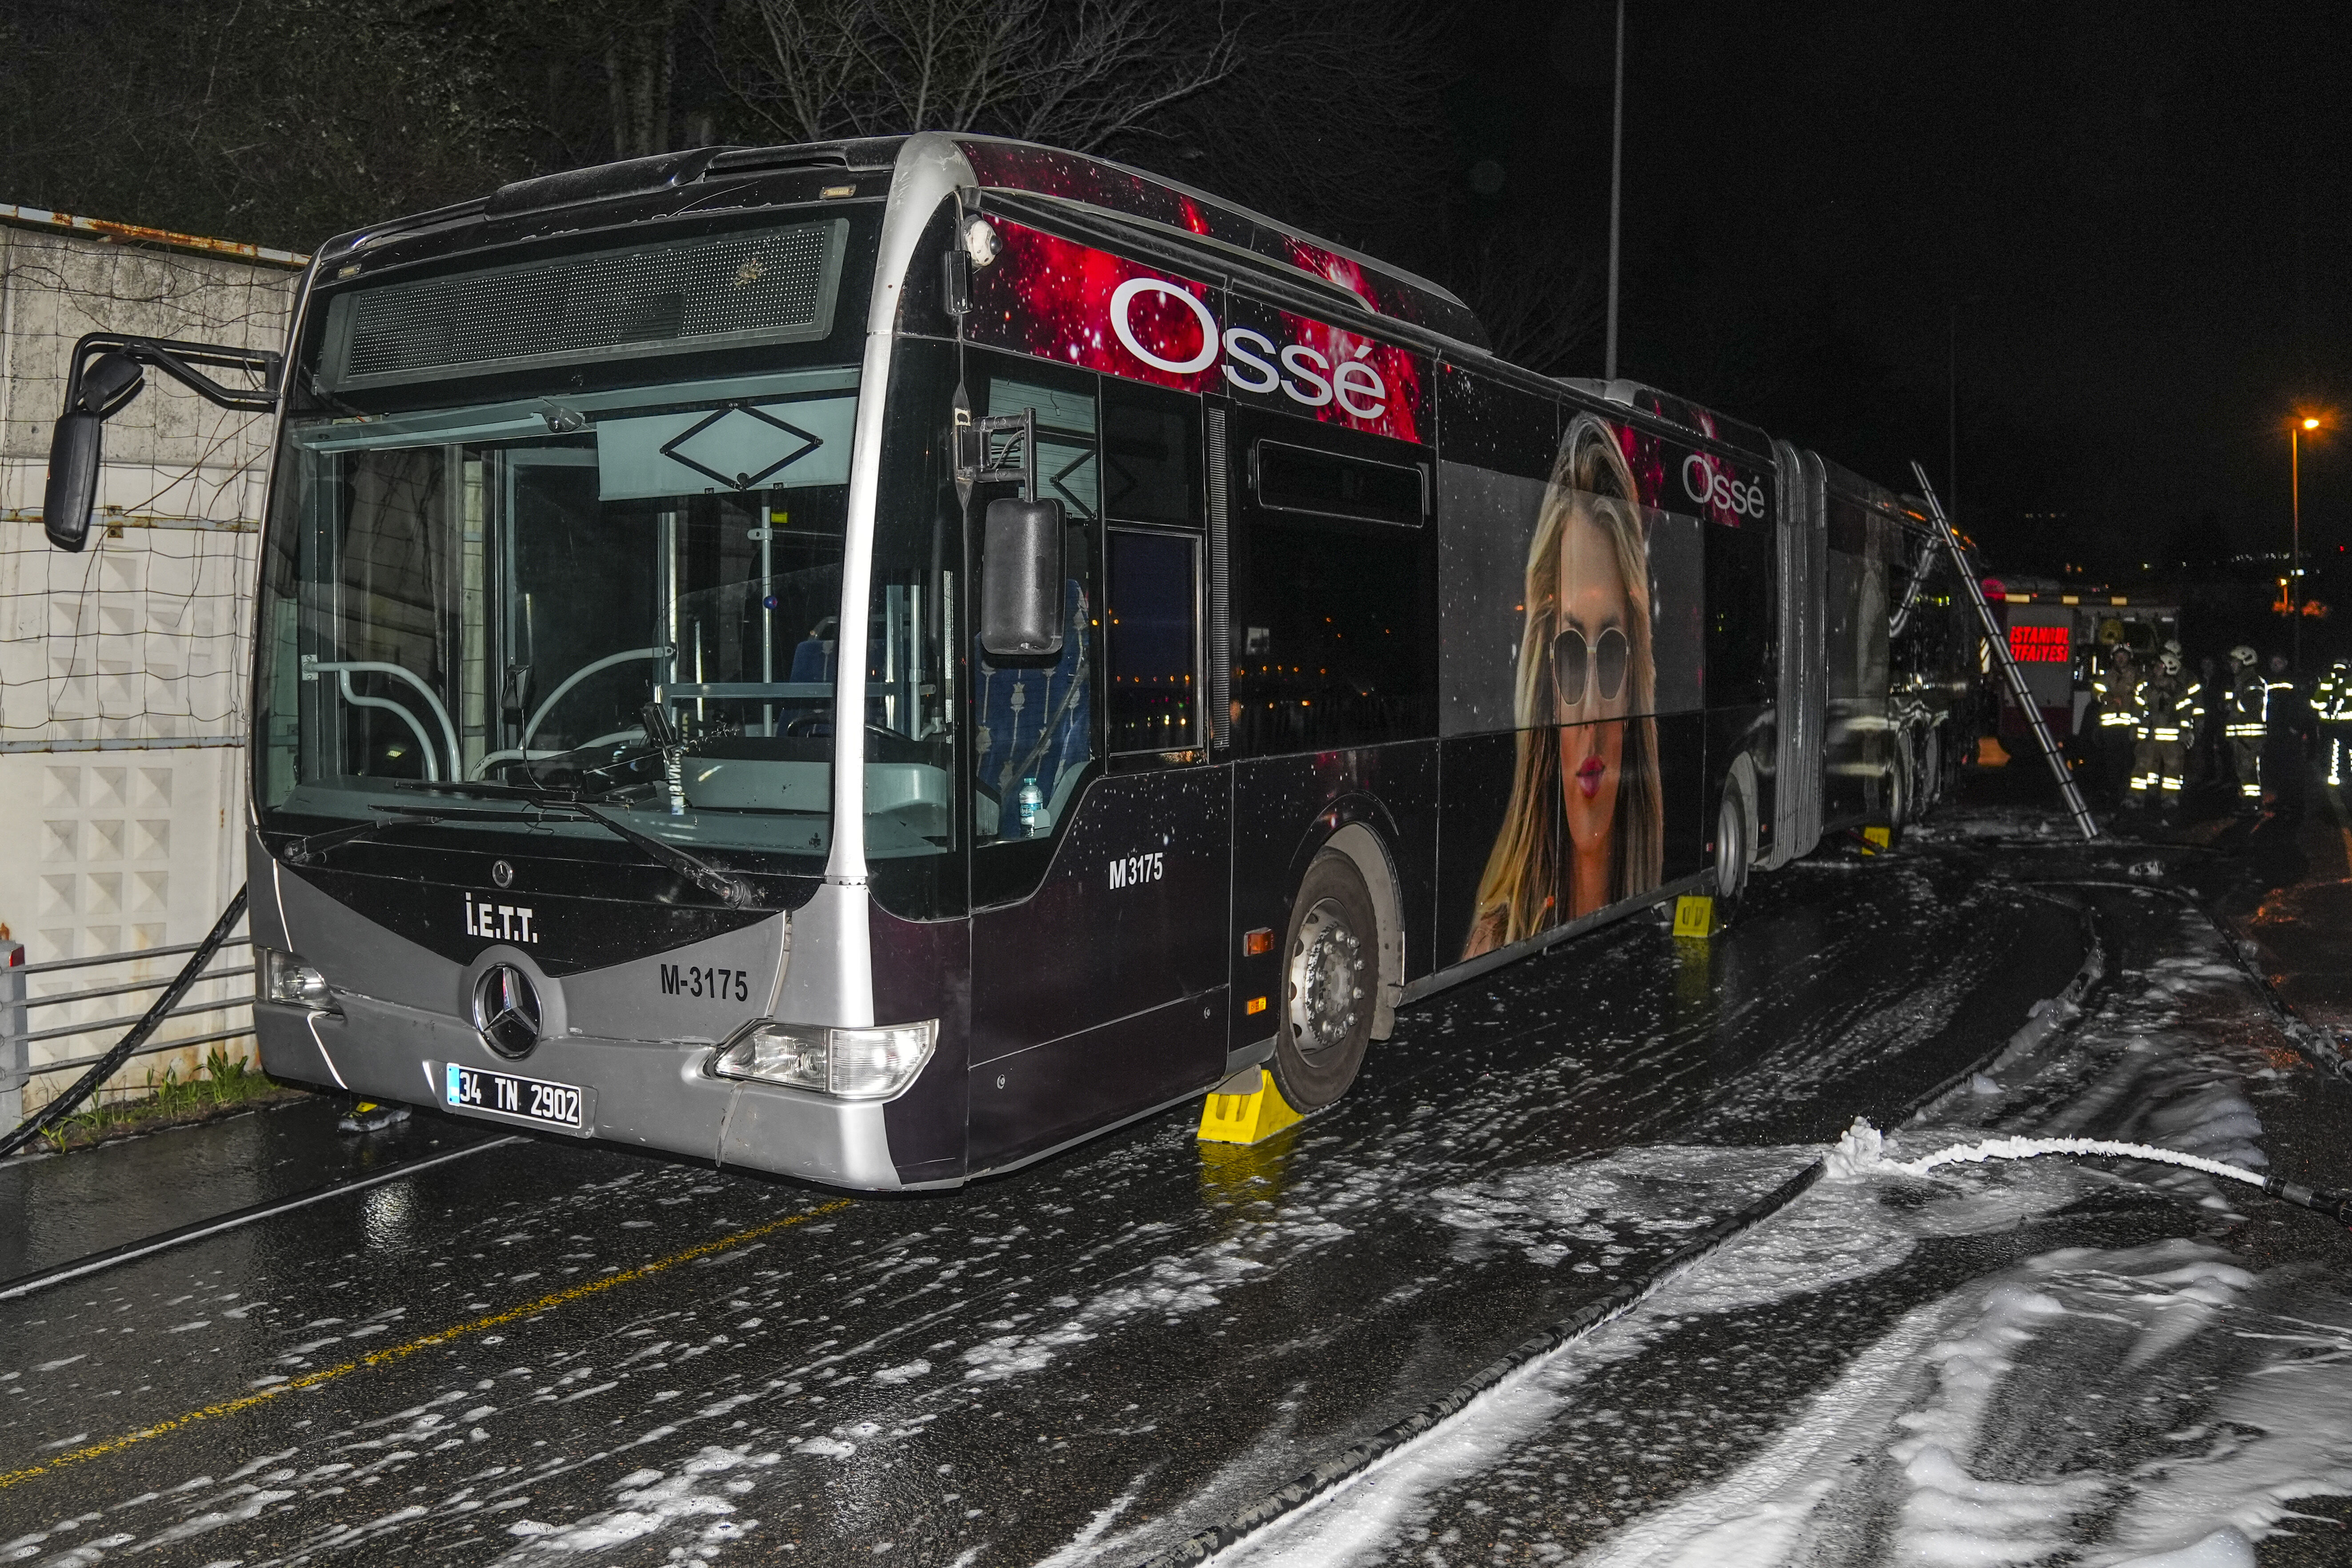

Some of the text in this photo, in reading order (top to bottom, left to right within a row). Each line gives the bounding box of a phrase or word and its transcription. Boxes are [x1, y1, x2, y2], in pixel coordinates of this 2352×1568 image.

[1110, 278, 1385, 419] Ossé
[1683, 454, 1764, 518] Ossé
[465, 892, 538, 943] İ.E.T.T.
[661, 964, 748, 1002] M-3175
[460, 1072, 578, 1123] 34 TN 2902
